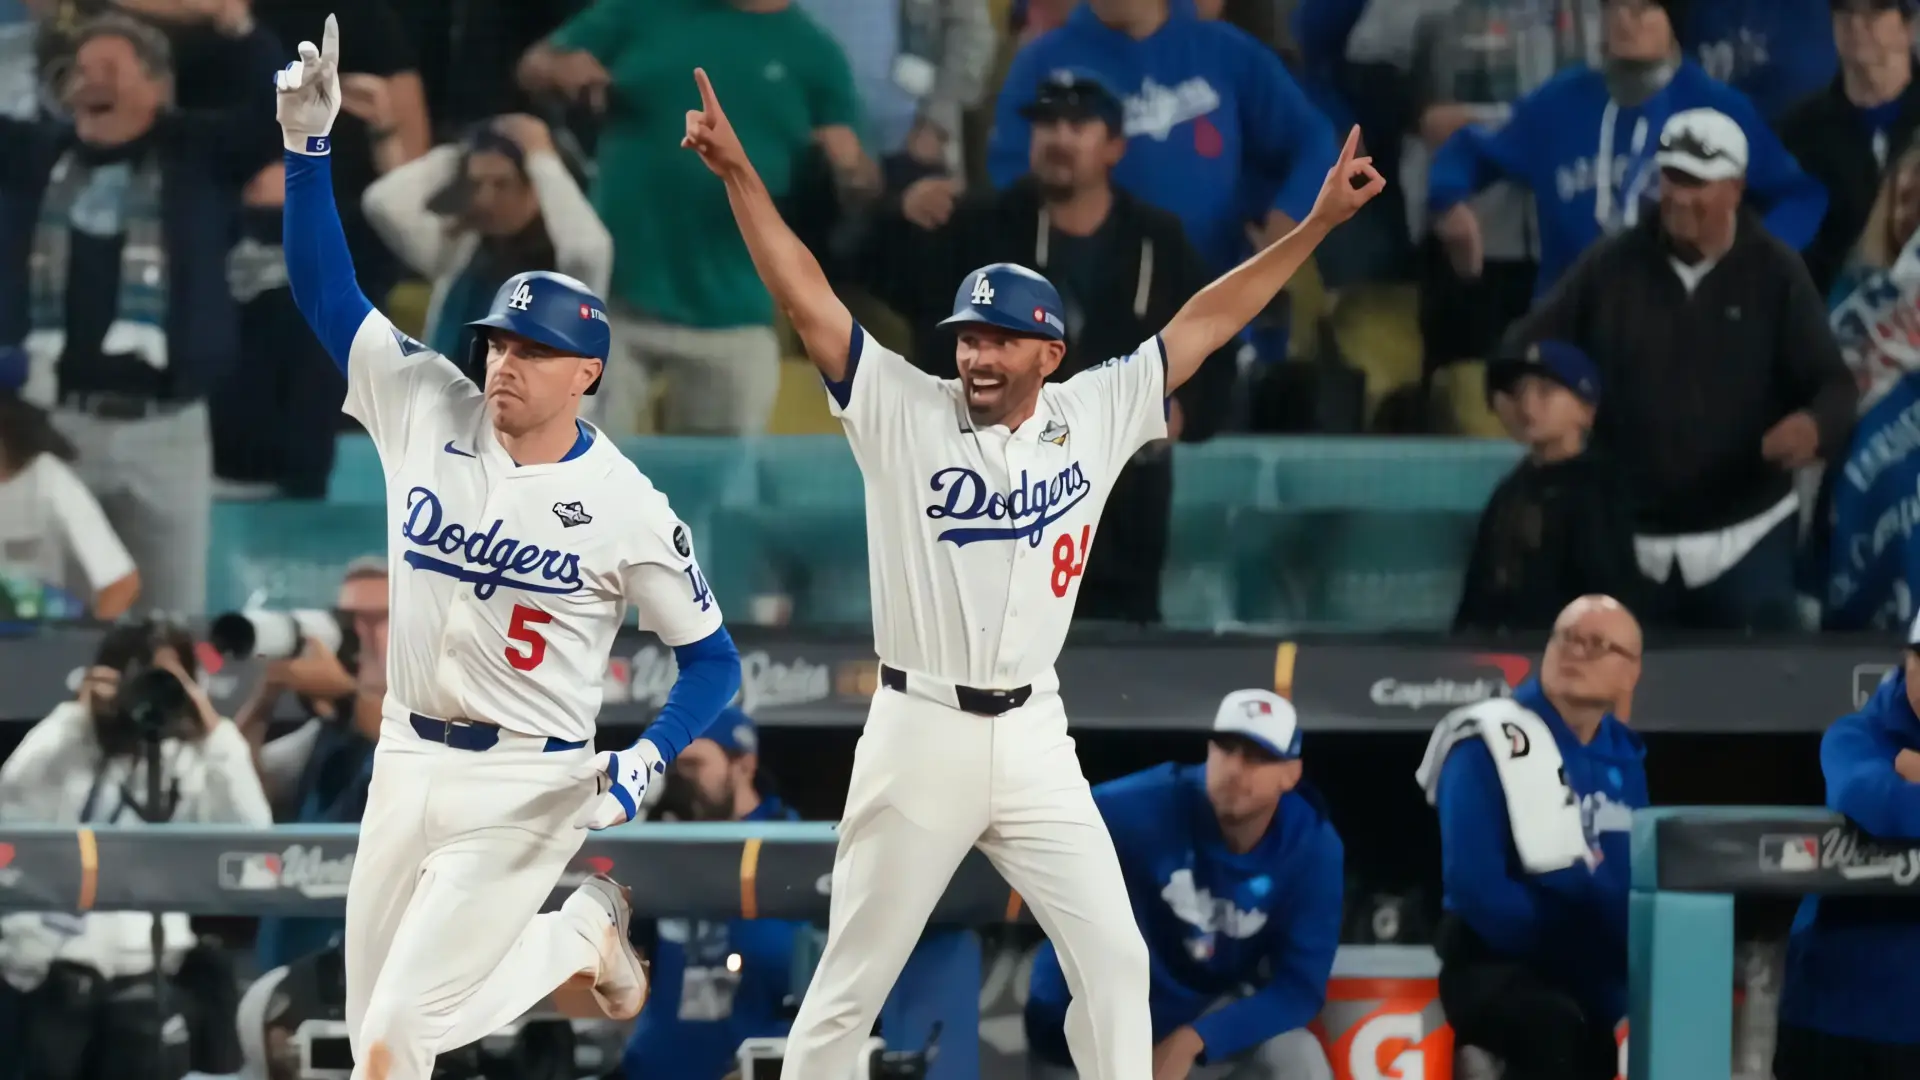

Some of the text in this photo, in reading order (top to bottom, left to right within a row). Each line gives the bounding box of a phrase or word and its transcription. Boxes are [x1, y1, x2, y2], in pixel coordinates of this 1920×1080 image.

[315, 138, 326, 151] 5
[508, 279, 533, 311] LA
[970, 272, 995, 305] LA
[926, 460, 1091, 548] Dodgers
[402, 486, 584, 600] Dodgers
[504, 603, 552, 672] 5
[1349, 1012, 1424, 1080] G
